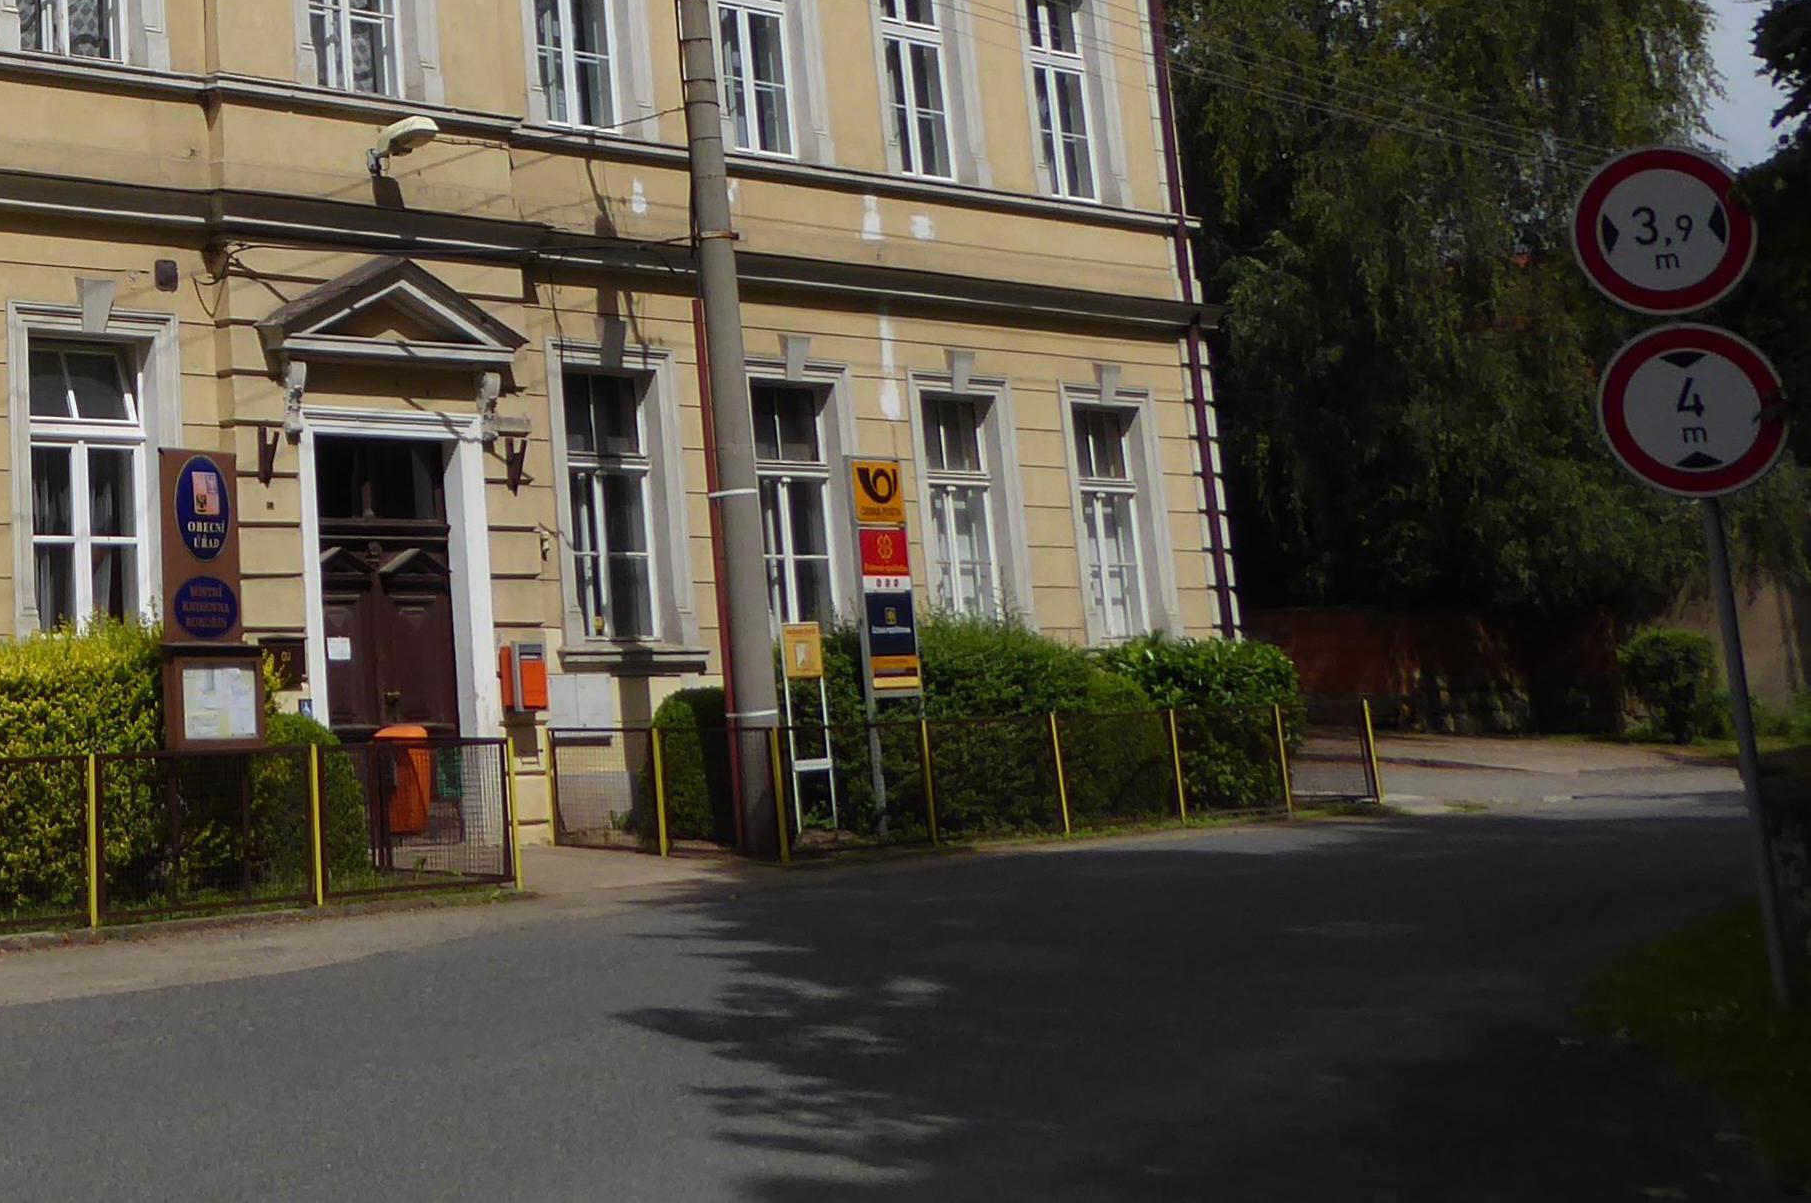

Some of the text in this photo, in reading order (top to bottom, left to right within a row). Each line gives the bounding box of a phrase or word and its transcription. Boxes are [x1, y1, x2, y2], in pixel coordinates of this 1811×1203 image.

[1632, 206, 1692, 245] 3,9
[1655, 253, 1680, 269] m
[1677, 377, 1704, 417] 4
[1682, 427, 1707, 444] m
[187, 519, 225, 533] OBECNÍ
[194, 534, 220, 548] ÚŘAD
